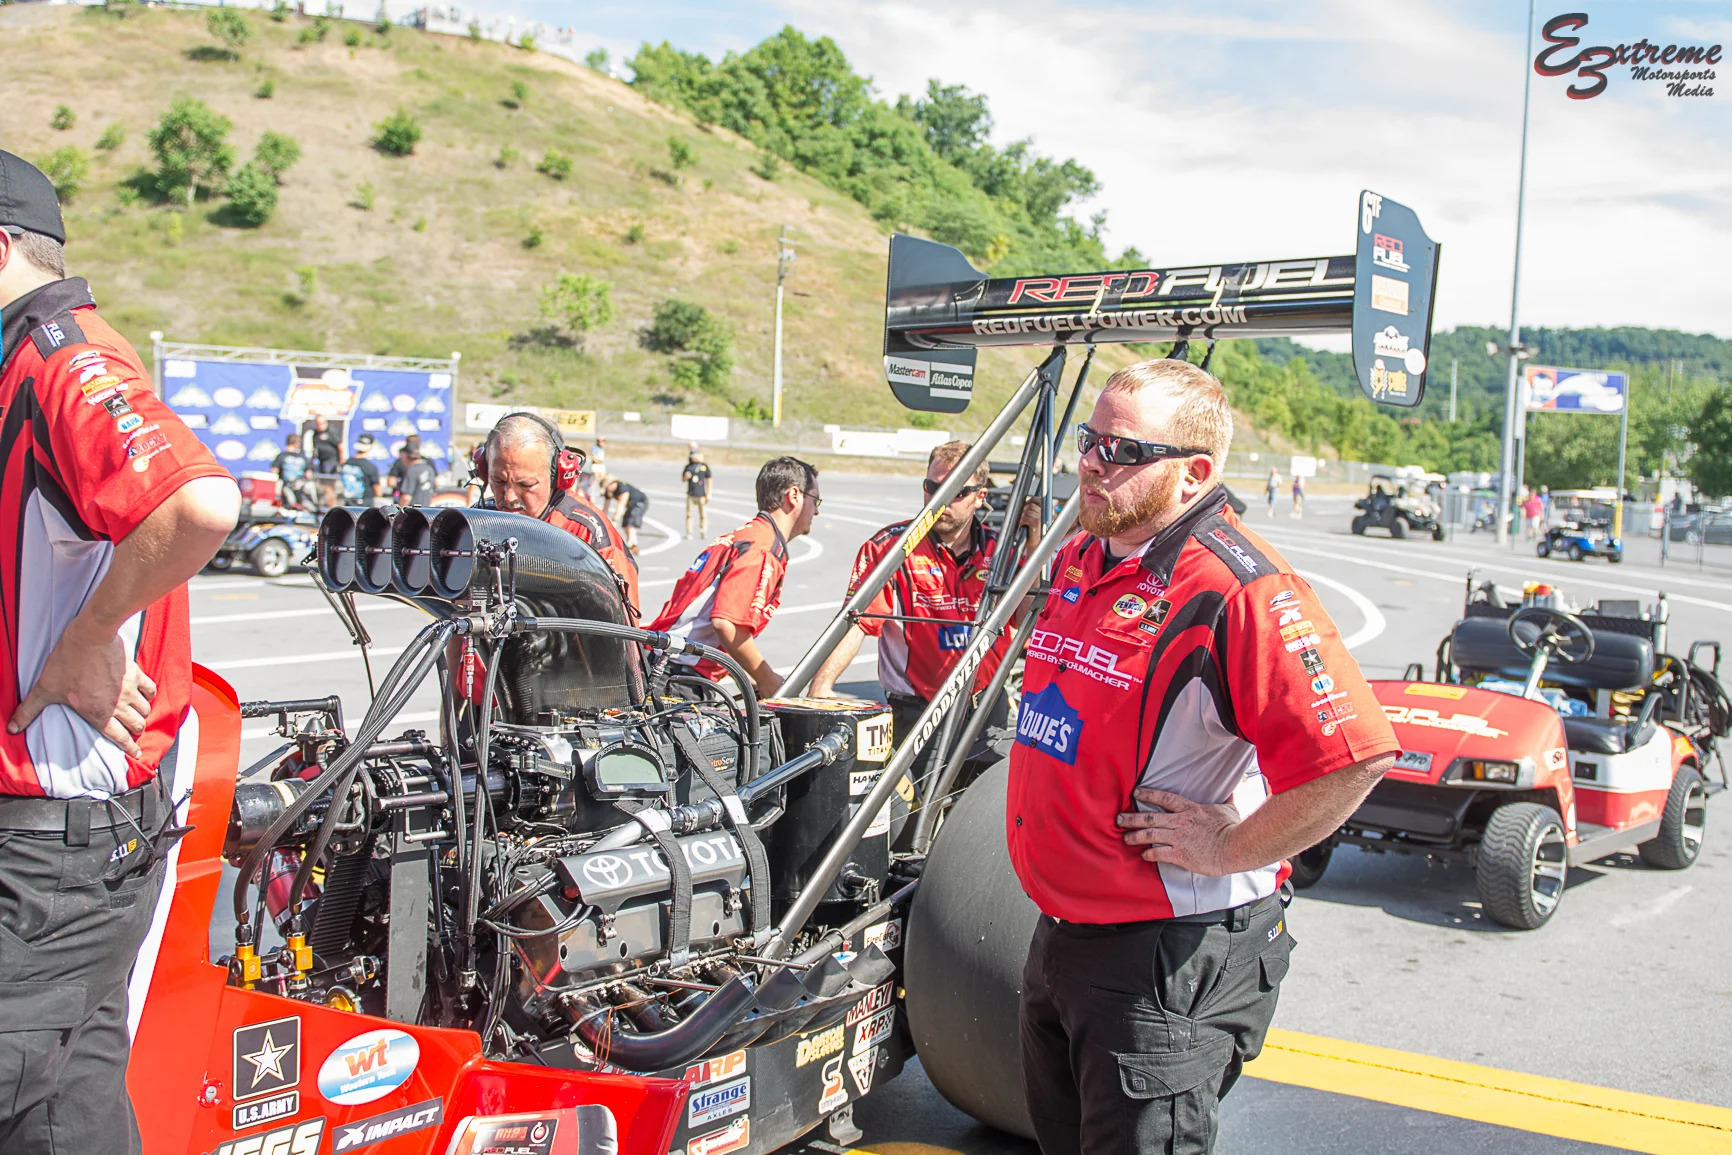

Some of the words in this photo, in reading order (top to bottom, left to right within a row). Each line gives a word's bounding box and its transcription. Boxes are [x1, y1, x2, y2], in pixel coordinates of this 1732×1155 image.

[972, 305, 1248, 336] REDFUELPOWER.COM
[888, 363, 926, 379] Mastercam
[121, 416, 141, 431] NAPA
[1136, 582, 1165, 597] TOYOTA
[1047, 655, 1059, 665] BY
[1058, 658, 1130, 691] SCHUMACHER
[913, 634, 990, 756] GOODYEAR
[858, 1014, 886, 1043] XRP
[692, 1084, 747, 1113] Strange
[365, 1106, 440, 1142] IMPACT
[707, 1107, 733, 1120] AXLES
